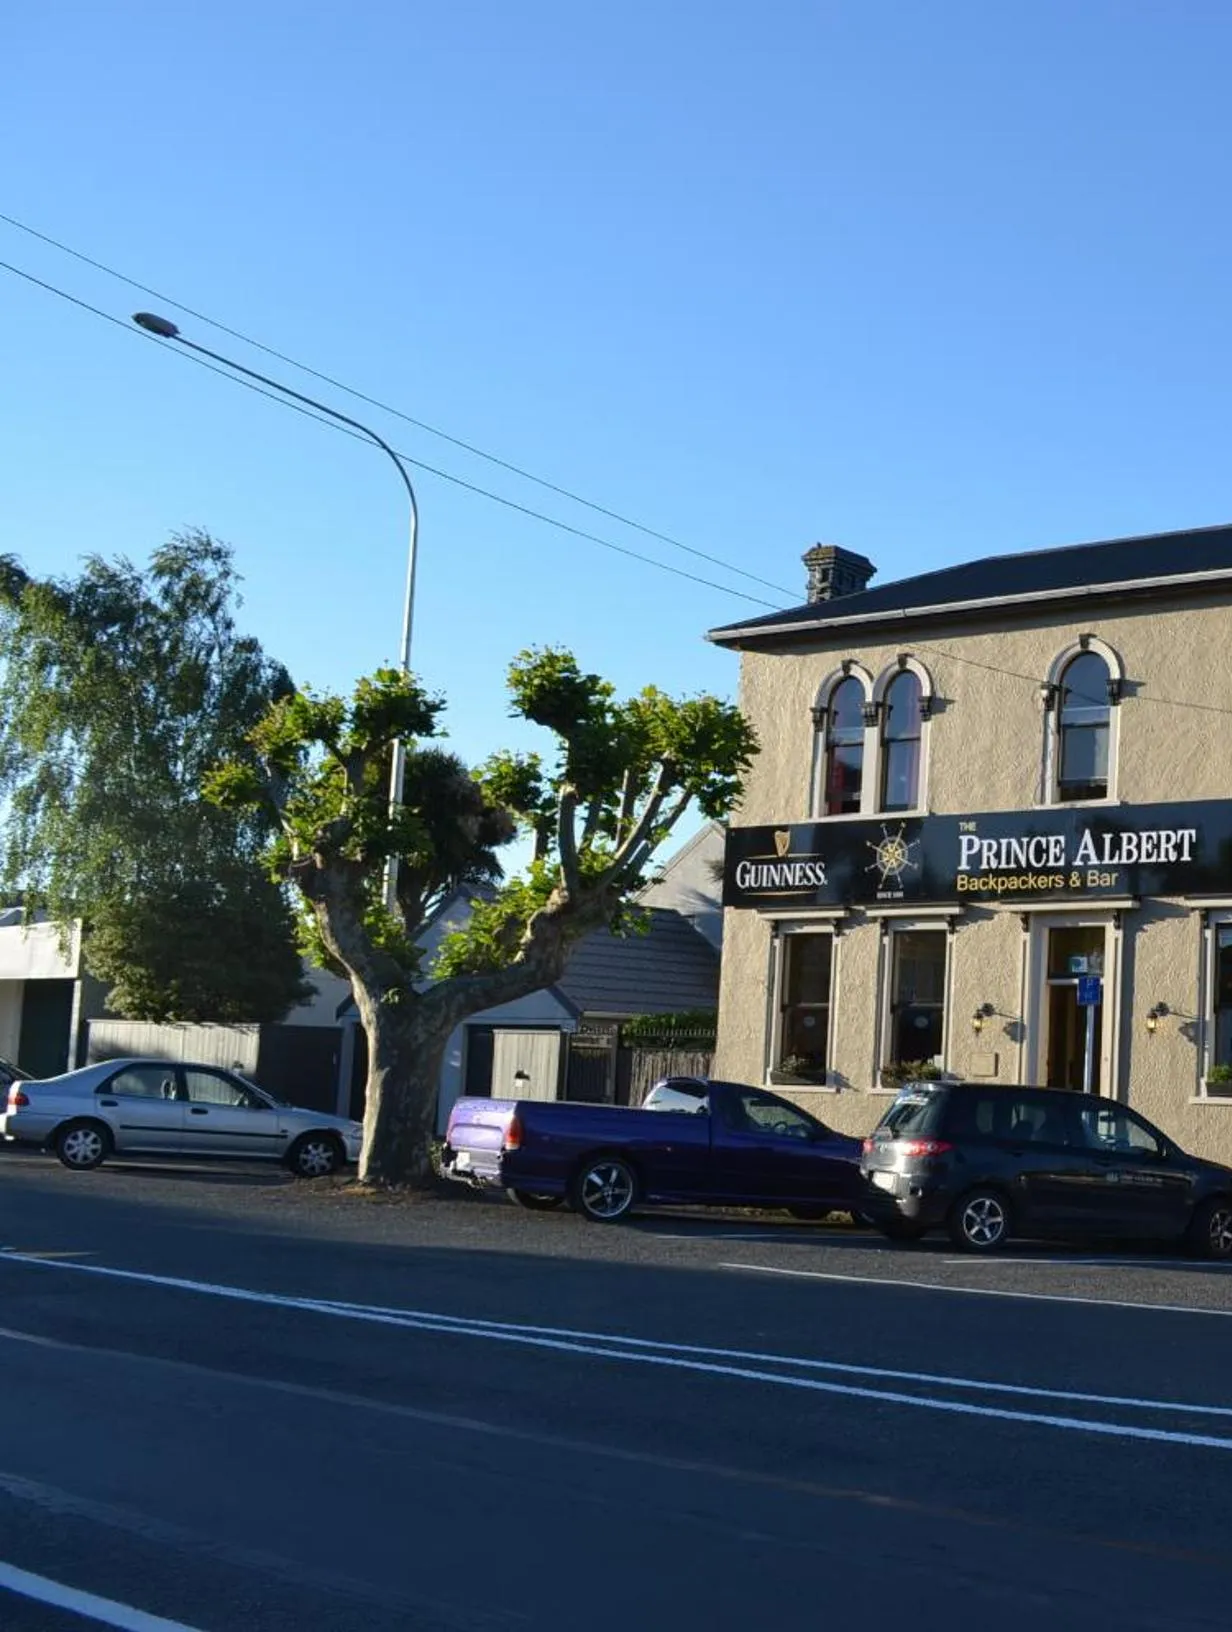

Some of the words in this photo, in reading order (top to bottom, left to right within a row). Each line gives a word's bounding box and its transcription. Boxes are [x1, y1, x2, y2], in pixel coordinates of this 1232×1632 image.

[958, 821, 976, 832] THE
[957, 834, 1065, 870] PRINCE
[1072, 828, 1196, 866] ALBERT
[736, 861, 828, 889] GUINNESS
[957, 872, 1065, 894] Backpackers
[1069, 870, 1080, 888] &
[1086, 869, 1118, 888] Bar
